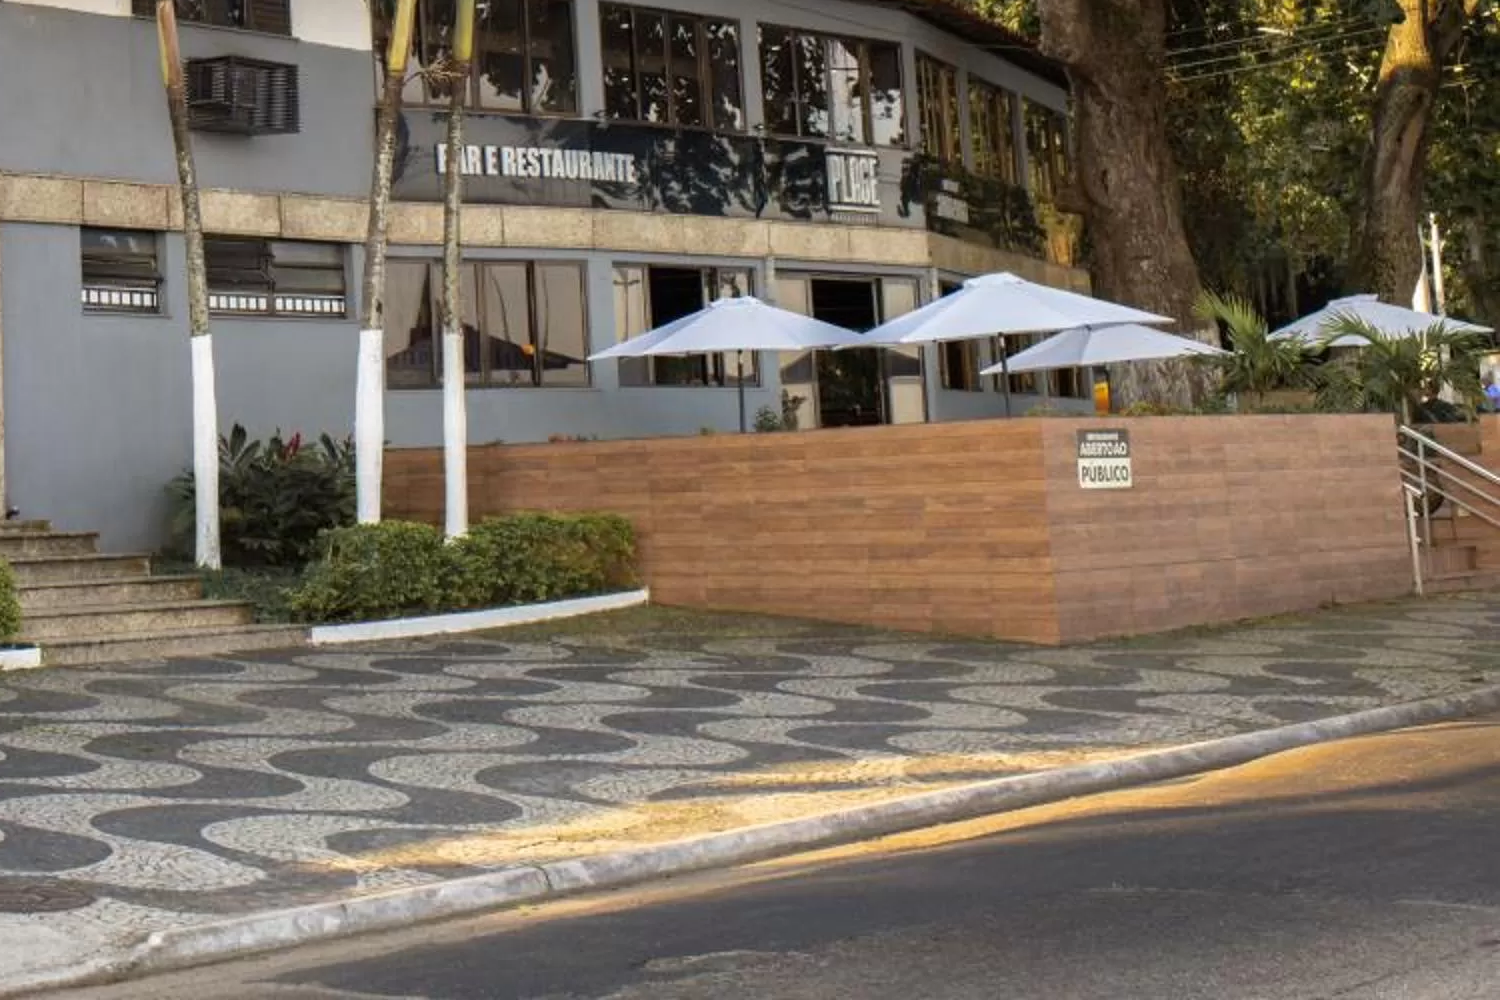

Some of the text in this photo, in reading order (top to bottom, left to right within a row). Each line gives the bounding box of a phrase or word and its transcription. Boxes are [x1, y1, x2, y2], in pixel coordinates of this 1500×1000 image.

[485, 145, 498, 175] E
[501, 146, 637, 183] RESTAURANTE
[826, 154, 880, 205] PLAGE
